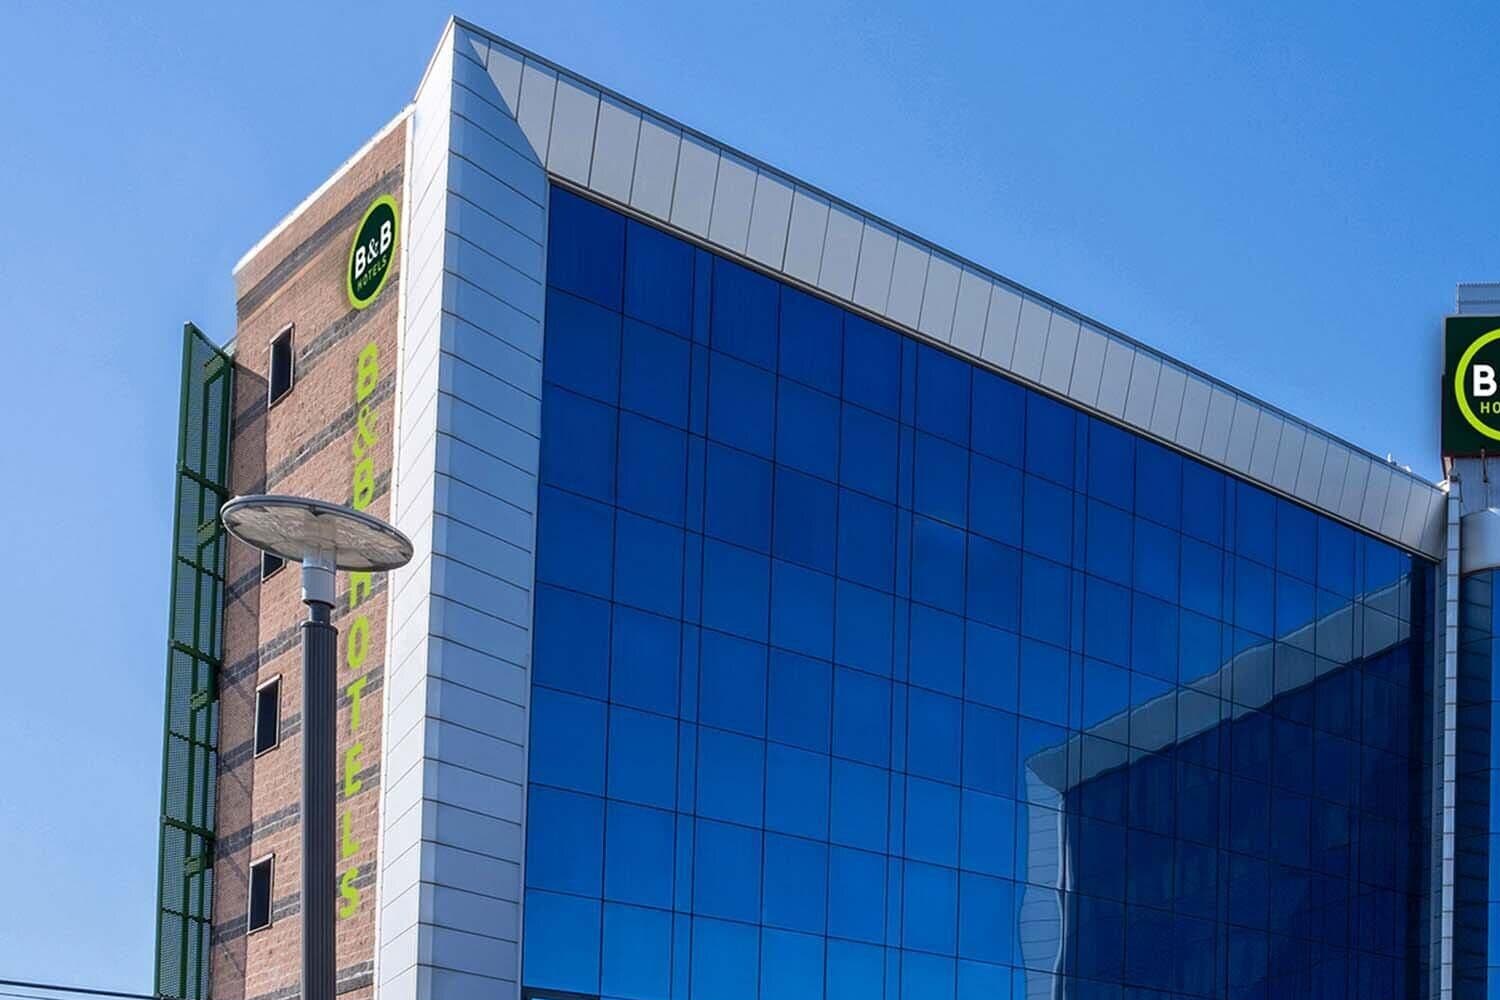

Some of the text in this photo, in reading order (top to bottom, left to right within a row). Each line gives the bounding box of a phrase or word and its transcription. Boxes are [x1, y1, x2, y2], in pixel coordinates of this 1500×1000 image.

[354, 219, 392, 280] B&B
[356, 254, 388, 292] HOTELS
[352, 341, 378, 511] B&B
